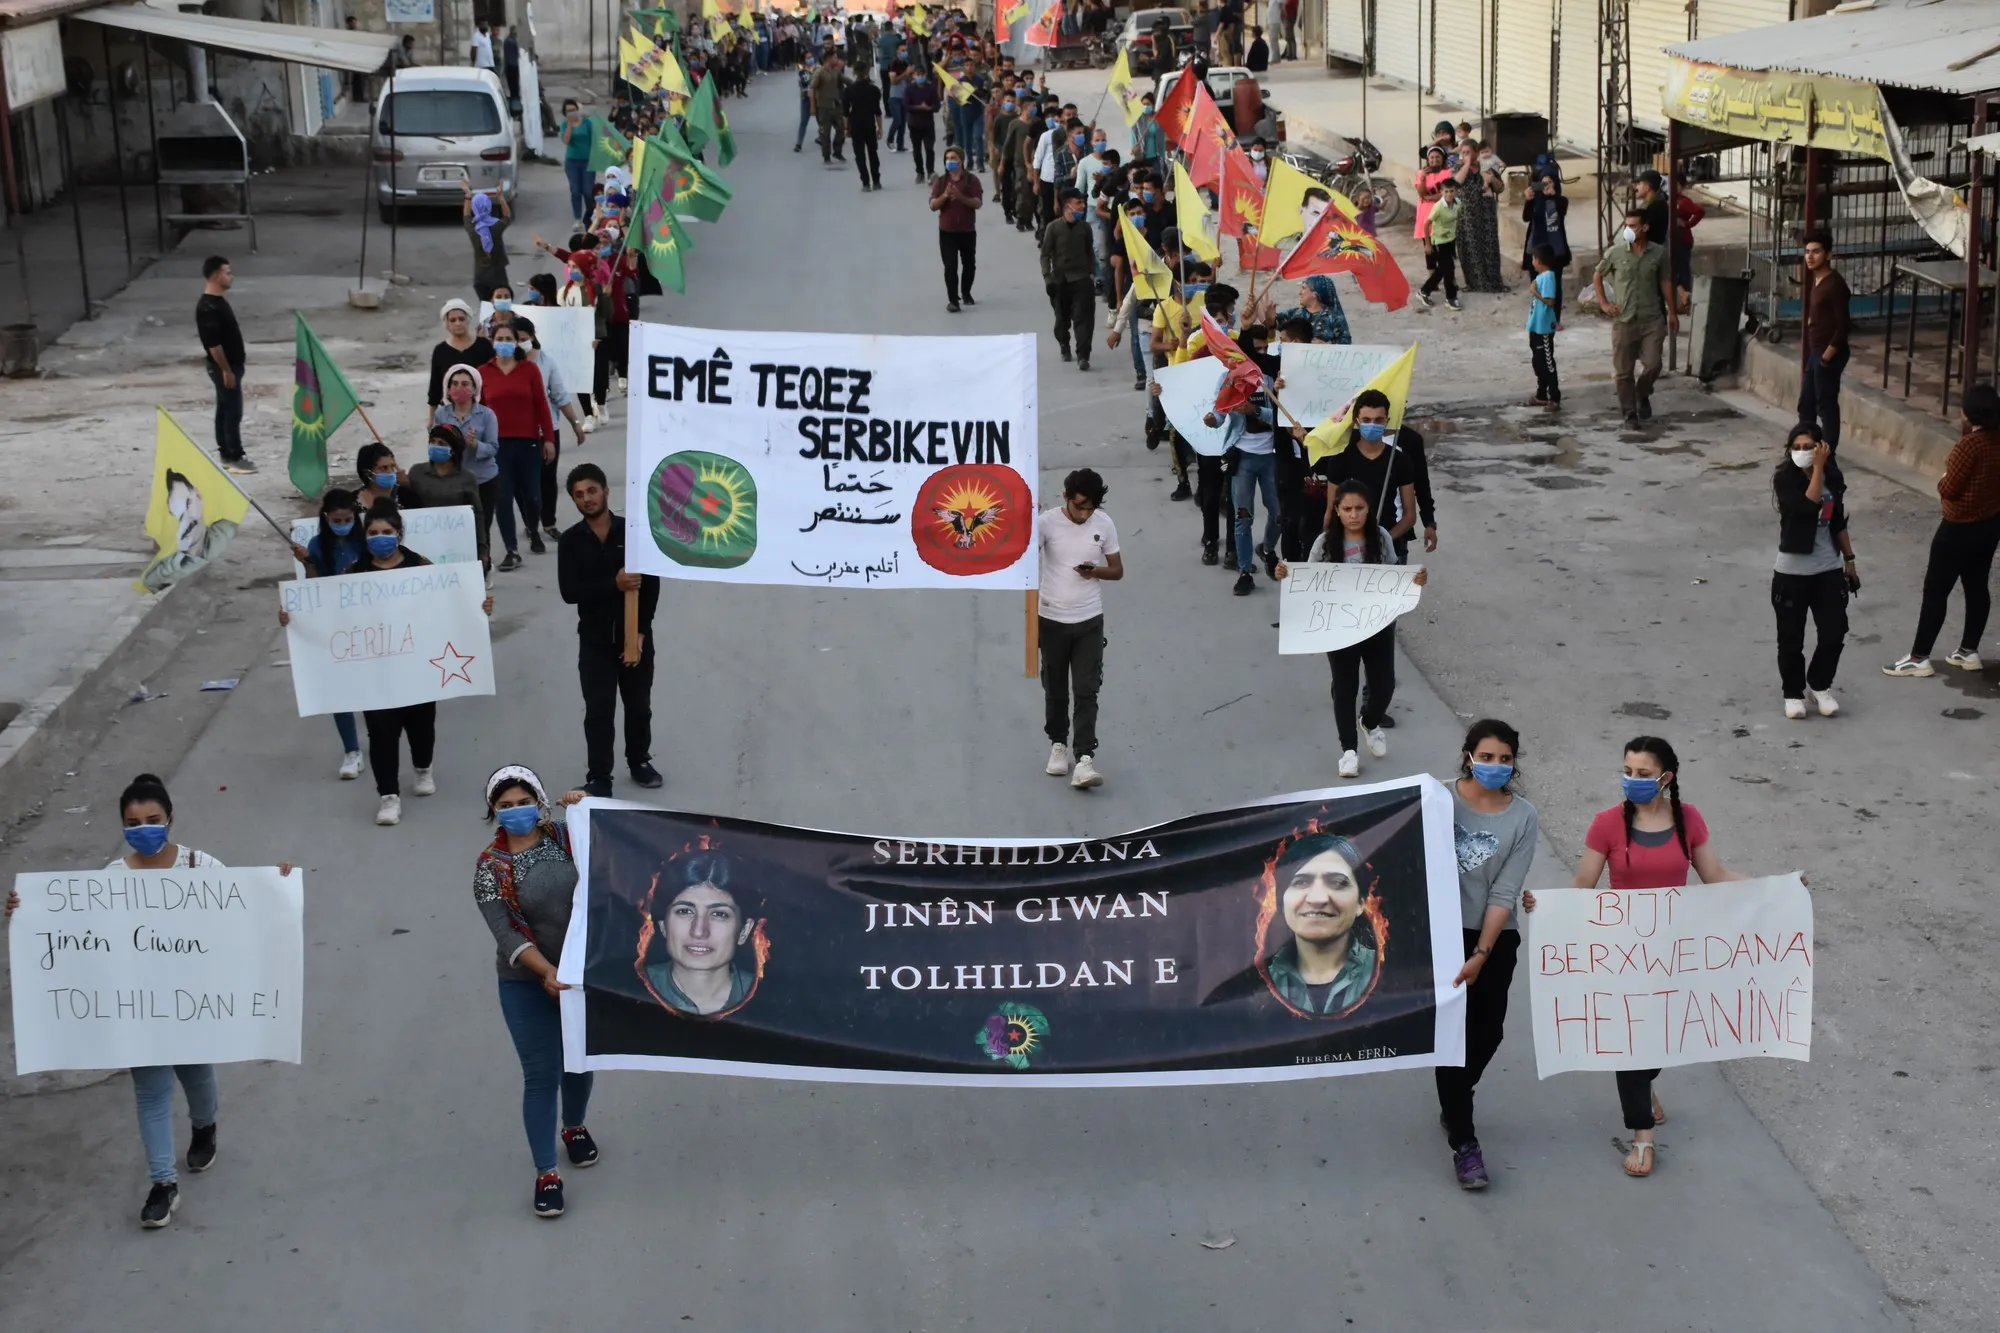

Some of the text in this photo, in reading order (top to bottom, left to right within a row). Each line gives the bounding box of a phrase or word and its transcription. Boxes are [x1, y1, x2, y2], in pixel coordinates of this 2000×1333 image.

[648, 347, 872, 414] EMÊ TEQEZ
[799, 416, 1011, 464] SERBIKEVIN
[791, 561, 861, 583] عفرين
[1289, 565, 1341, 594] EMÊ
[339, 572, 462, 609] BERXWEDANA
[873, 839, 1160, 866] SERHILDANA
[47, 877, 247, 912] SERHILDANA
[865, 891, 1170, 932] JINÊN CIWAN
[1588, 888, 1682, 938] BIJÎ
[133, 925, 209, 953] Ciwan
[1540, 931, 1812, 977] BERXWEDANA
[860, 958, 1179, 990] TOLHILDAN E
[47, 988, 234, 1021] TOLHILDAN
[1554, 976, 1808, 1056] HEFTANÎNÊ
[1295, 1045, 1397, 1064] HERÊMA EFRÎN
